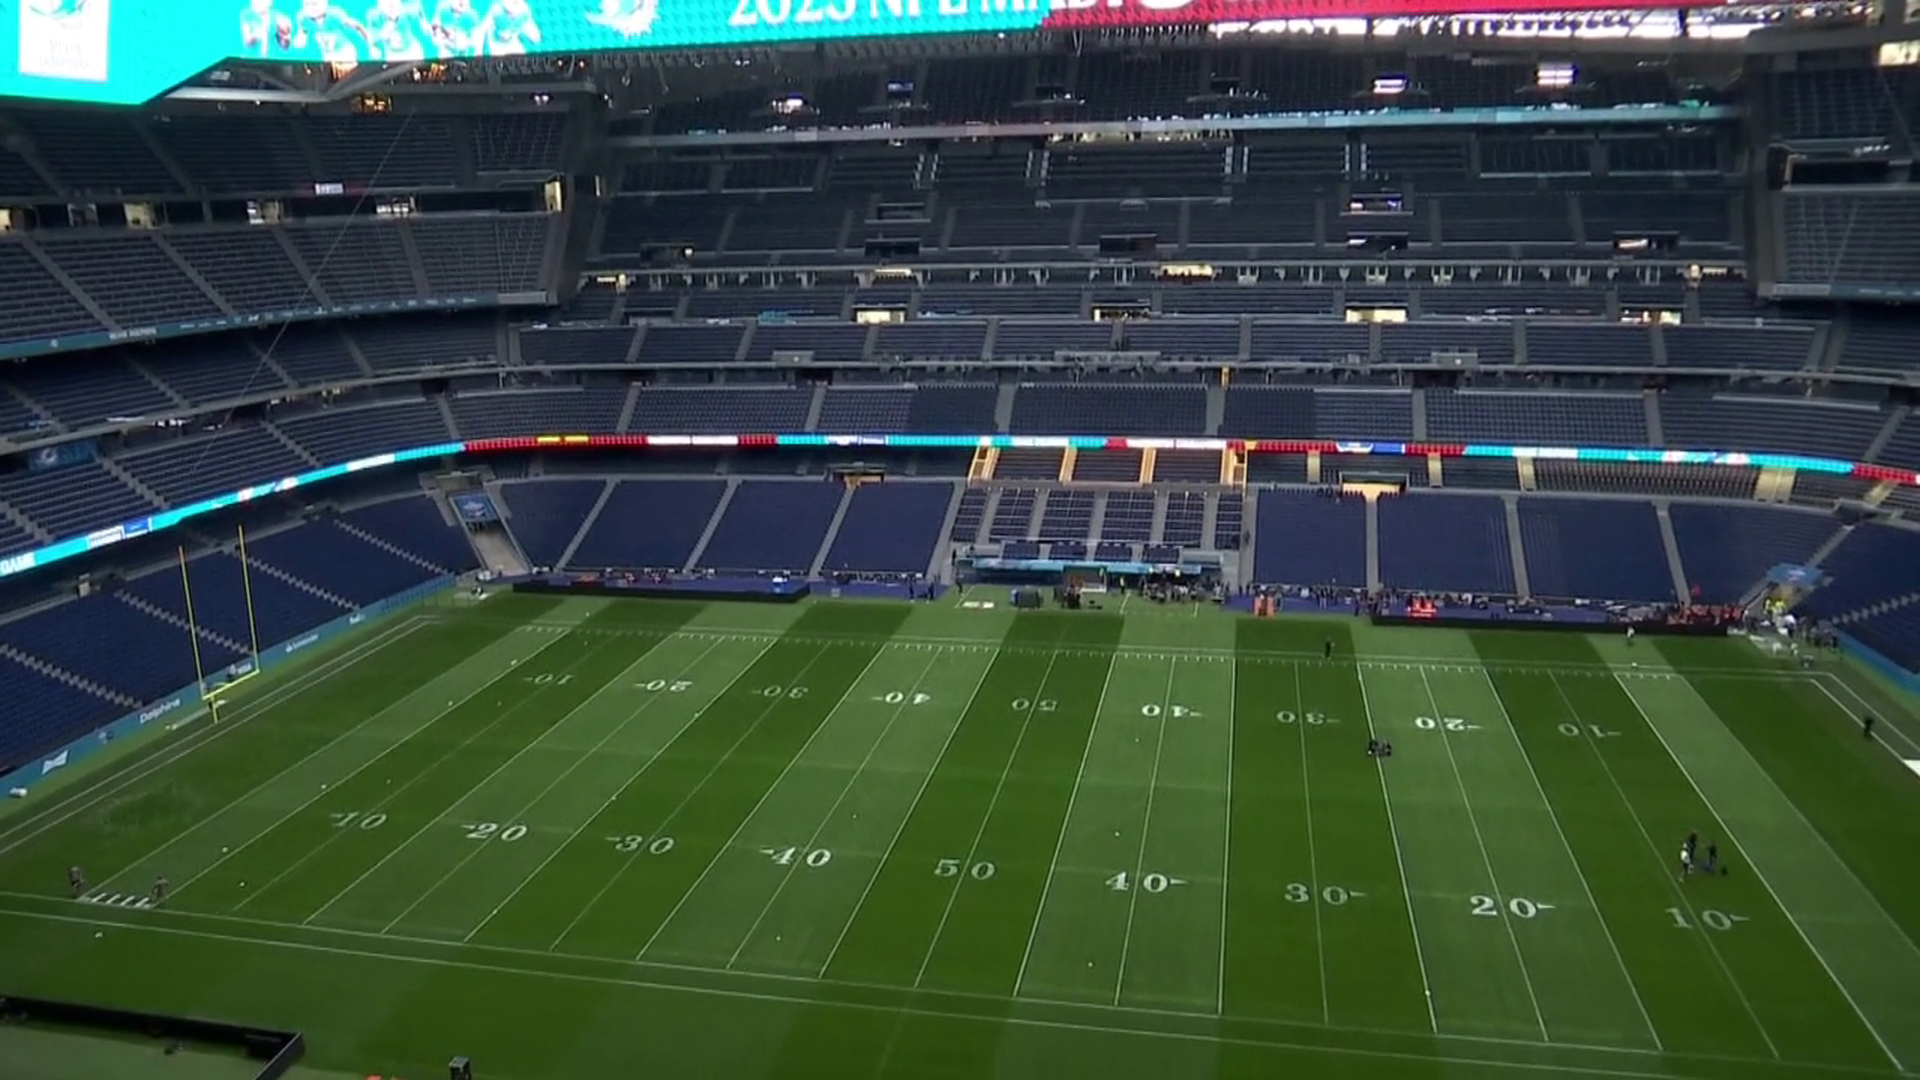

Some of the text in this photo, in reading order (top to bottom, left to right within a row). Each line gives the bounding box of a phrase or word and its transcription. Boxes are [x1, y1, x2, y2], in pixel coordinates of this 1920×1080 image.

[534, 673, 573, 685] 10
[646, 679, 693, 692] 20
[763, 685, 809, 699] 30
[885, 691, 930, 705] 40
[1012, 698, 1057, 712] 50
[1142, 704, 1189, 718] 40
[1277, 710, 1325, 725] 30
[1415, 716, 1466, 731] 20
[1558, 723, 1606, 738] 10
[333, 811, 387, 829] 10
[465, 822, 527, 841] 20
[614, 834, 675, 854] 30
[771, 847, 832, 867] 40
[933, 858, 996, 880] 50
[1105, 871, 1169, 893] 40
[1284, 883, 1349, 905] 30
[1470, 895, 1538, 919] 20
[1665, 907, 1733, 930] 10
